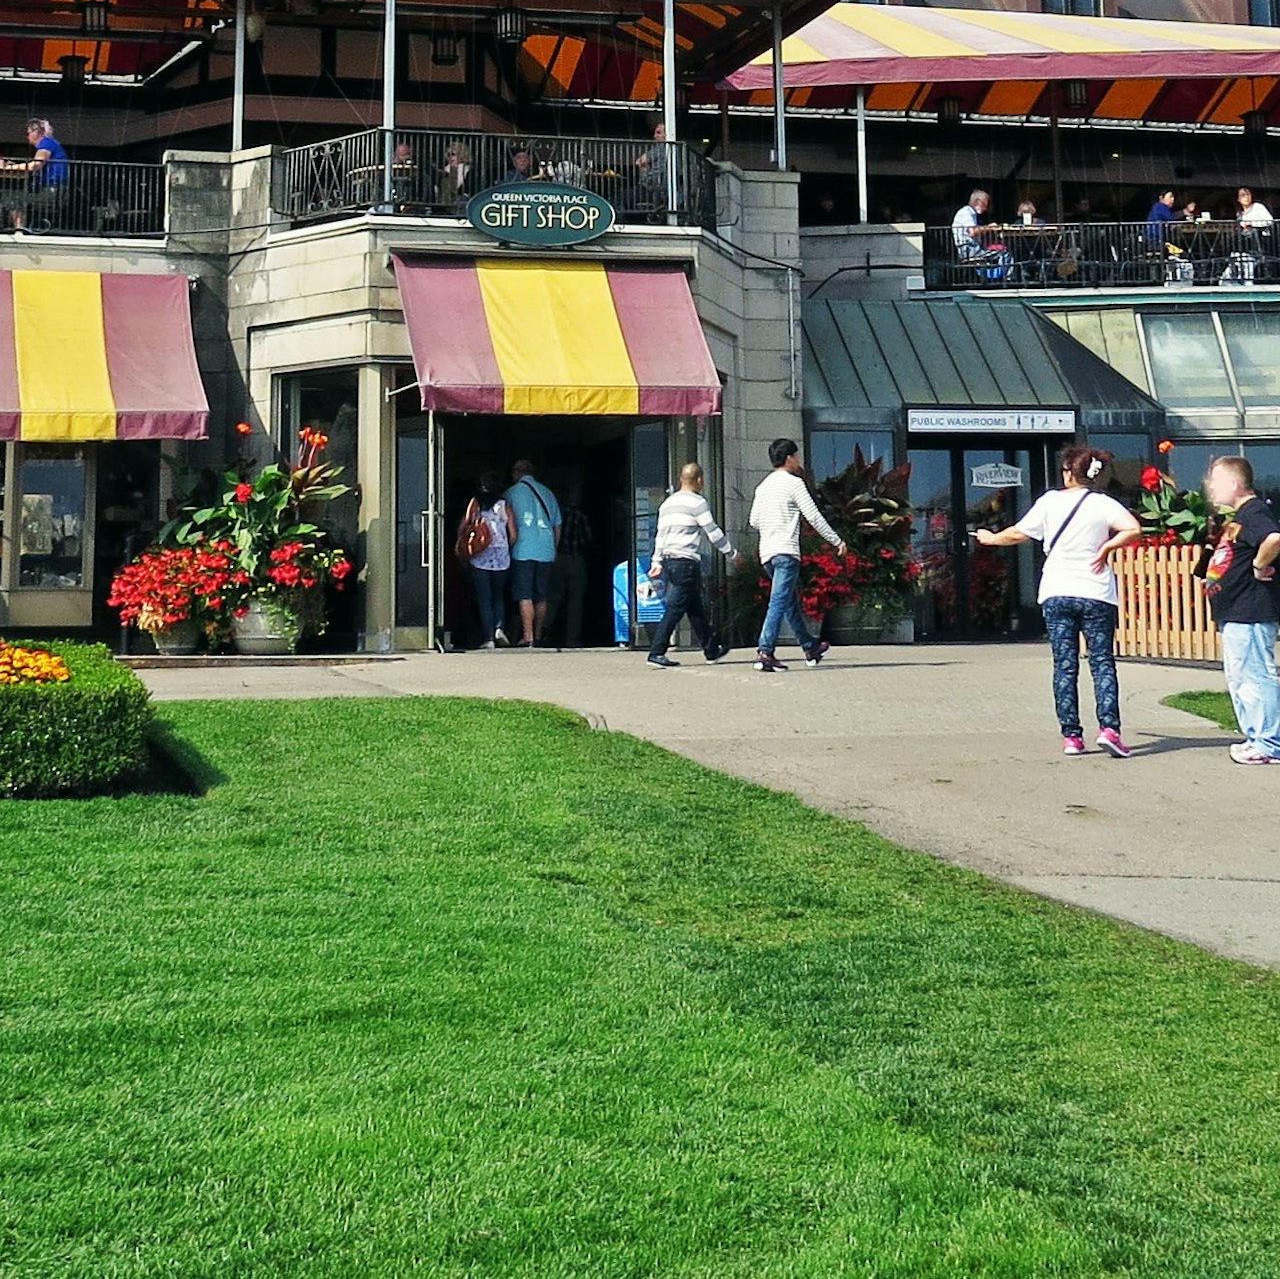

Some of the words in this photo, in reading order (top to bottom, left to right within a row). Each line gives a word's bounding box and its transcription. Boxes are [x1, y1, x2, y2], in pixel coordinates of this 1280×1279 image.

[492, 193, 522, 202] QUEEN
[524, 194, 563, 203] VICTORIA
[564, 195, 588, 204] PLACE
[481, 203, 532, 227] GIFT
[536, 205, 600, 230] SHOP
[911, 417, 945, 426] PUBLIC
[947, 417, 1007, 426] WASHROOMS
